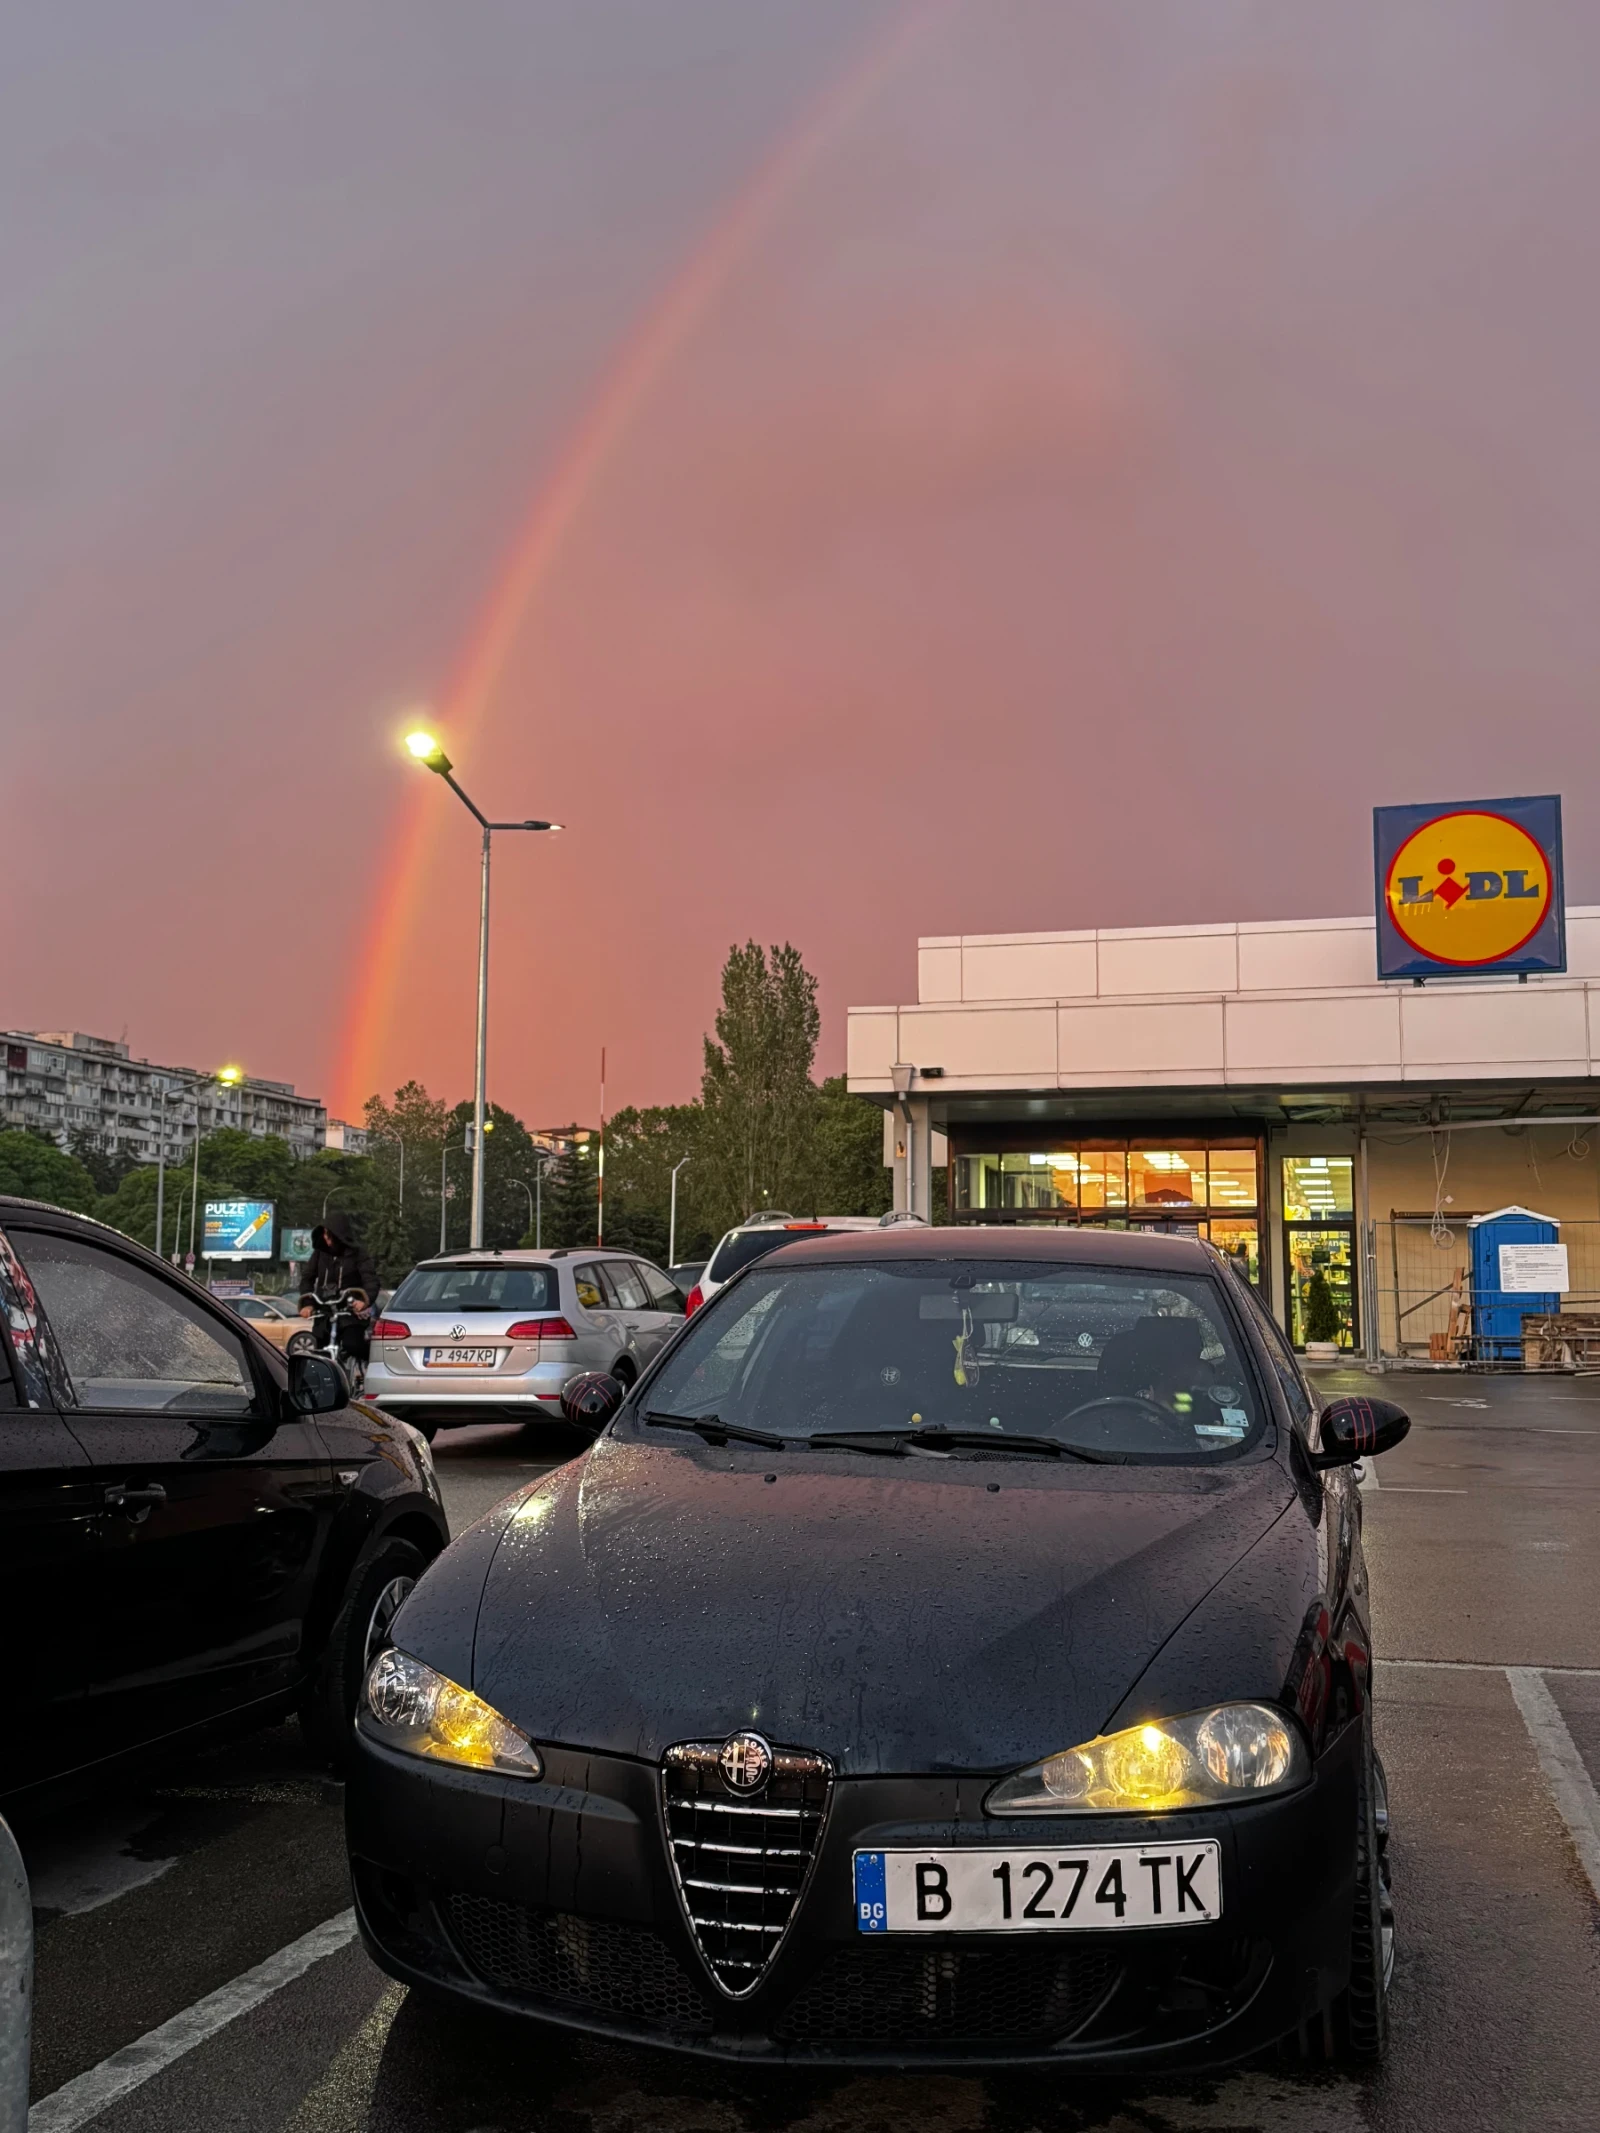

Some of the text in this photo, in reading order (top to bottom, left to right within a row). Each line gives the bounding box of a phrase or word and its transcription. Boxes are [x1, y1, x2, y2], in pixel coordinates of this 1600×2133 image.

[205, 1203, 245, 1215] PULZE
[435, 1349, 493, 1362] P 4947 KP
[720, 1738, 768, 1769] ALFA ROMEO
[915, 1853, 1207, 1921] B 1274 TK
[860, 1903, 884, 1919] BG
